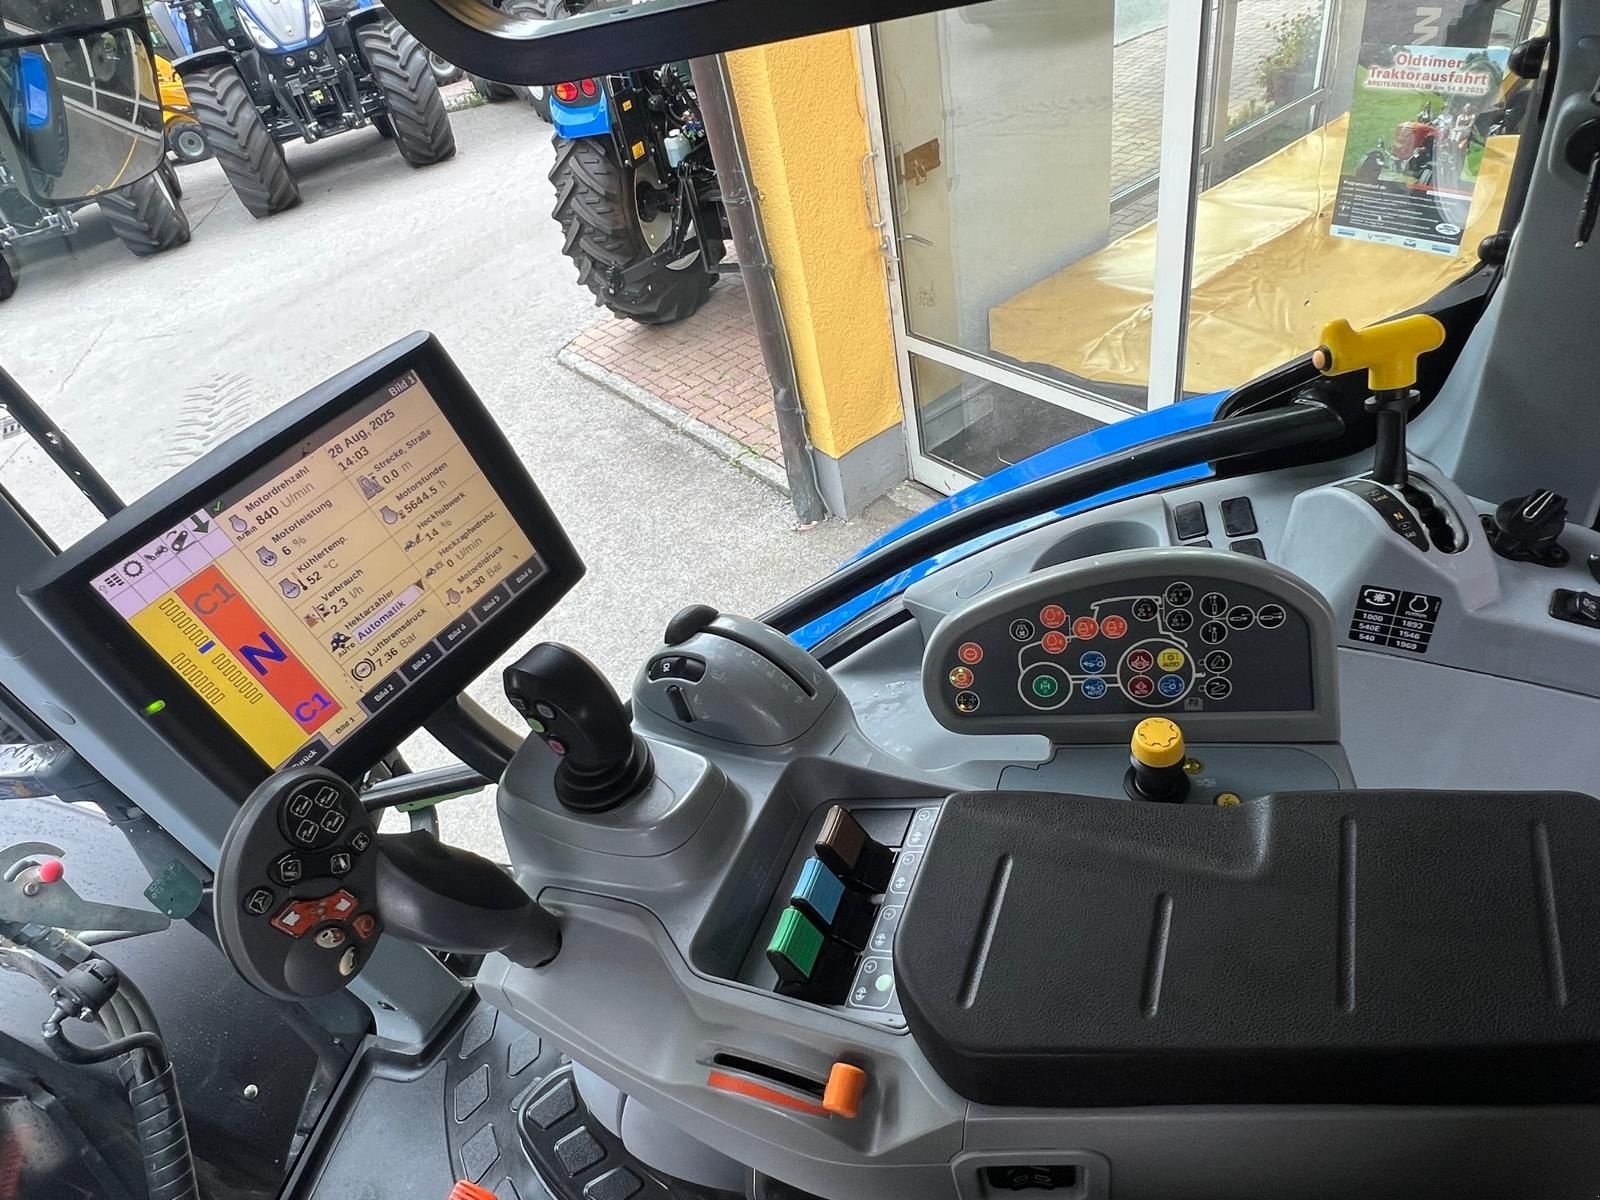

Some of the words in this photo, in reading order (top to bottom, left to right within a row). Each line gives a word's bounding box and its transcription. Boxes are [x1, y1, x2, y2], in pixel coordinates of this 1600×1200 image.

[1396, 53, 1464, 69] Oldtimer
[1369, 67, 1488, 86] Traktorausfahrt
[388, 377, 408, 397] Bild
[408, 375, 416, 384] 1
[328, 444, 344, 459] 28
[370, 409, 395, 431] 2025
[338, 446, 370, 472] 14:03
[374, 448, 408, 472] Strecke,
[406, 428, 432, 450] Straße
[382, 469, 400, 485] 0.0
[401, 461, 413, 473] m
[396, 461, 448, 502] Motorstunden
[245, 466, 310, 512] Motordrehzahl
[404, 486, 438, 514] 5644.5
[439, 480, 448, 488] h
[256, 506, 279, 526] 840
[280, 482, 315, 508] U/min
[416, 492, 466, 530] Heckhubwerk
[271, 499, 333, 544] Motorleistung
[281, 546, 292, 556] 6
[292, 537, 306, 548] %
[425, 528, 440, 542] 14
[446, 559, 455, 568] 0
[455, 537, 482, 560] U/min
[306, 571, 322, 585] 52
[321, 568, 364, 601] Verbrauch
[465, 575, 486, 594] 4.30
[486, 562, 504, 579] Bar
[194, 582, 236, 616] C1
[330, 597, 350, 614] 2.3
[358, 600, 406, 641] Automatik
[1358, 622, 1381, 632] 540E
[1362, 612, 1384, 622] 1000
[1402, 620, 1424, 630] 1893
[368, 608, 427, 657] Luftbremsdruck
[448, 628, 462, 641] Bild
[1358, 633, 1376, 642] 540
[1396, 640, 1418, 650] 1969
[1399, 630, 1421, 640] 1546
[238, 631, 288, 676] N
[375, 647, 398, 668] 7.36
[400, 633, 417, 649] Bar
[412, 657, 427, 671] Bild
[294, 692, 332, 722] C1
[374, 689, 390, 702] Bild
[335, 720, 350, 735] Bild
